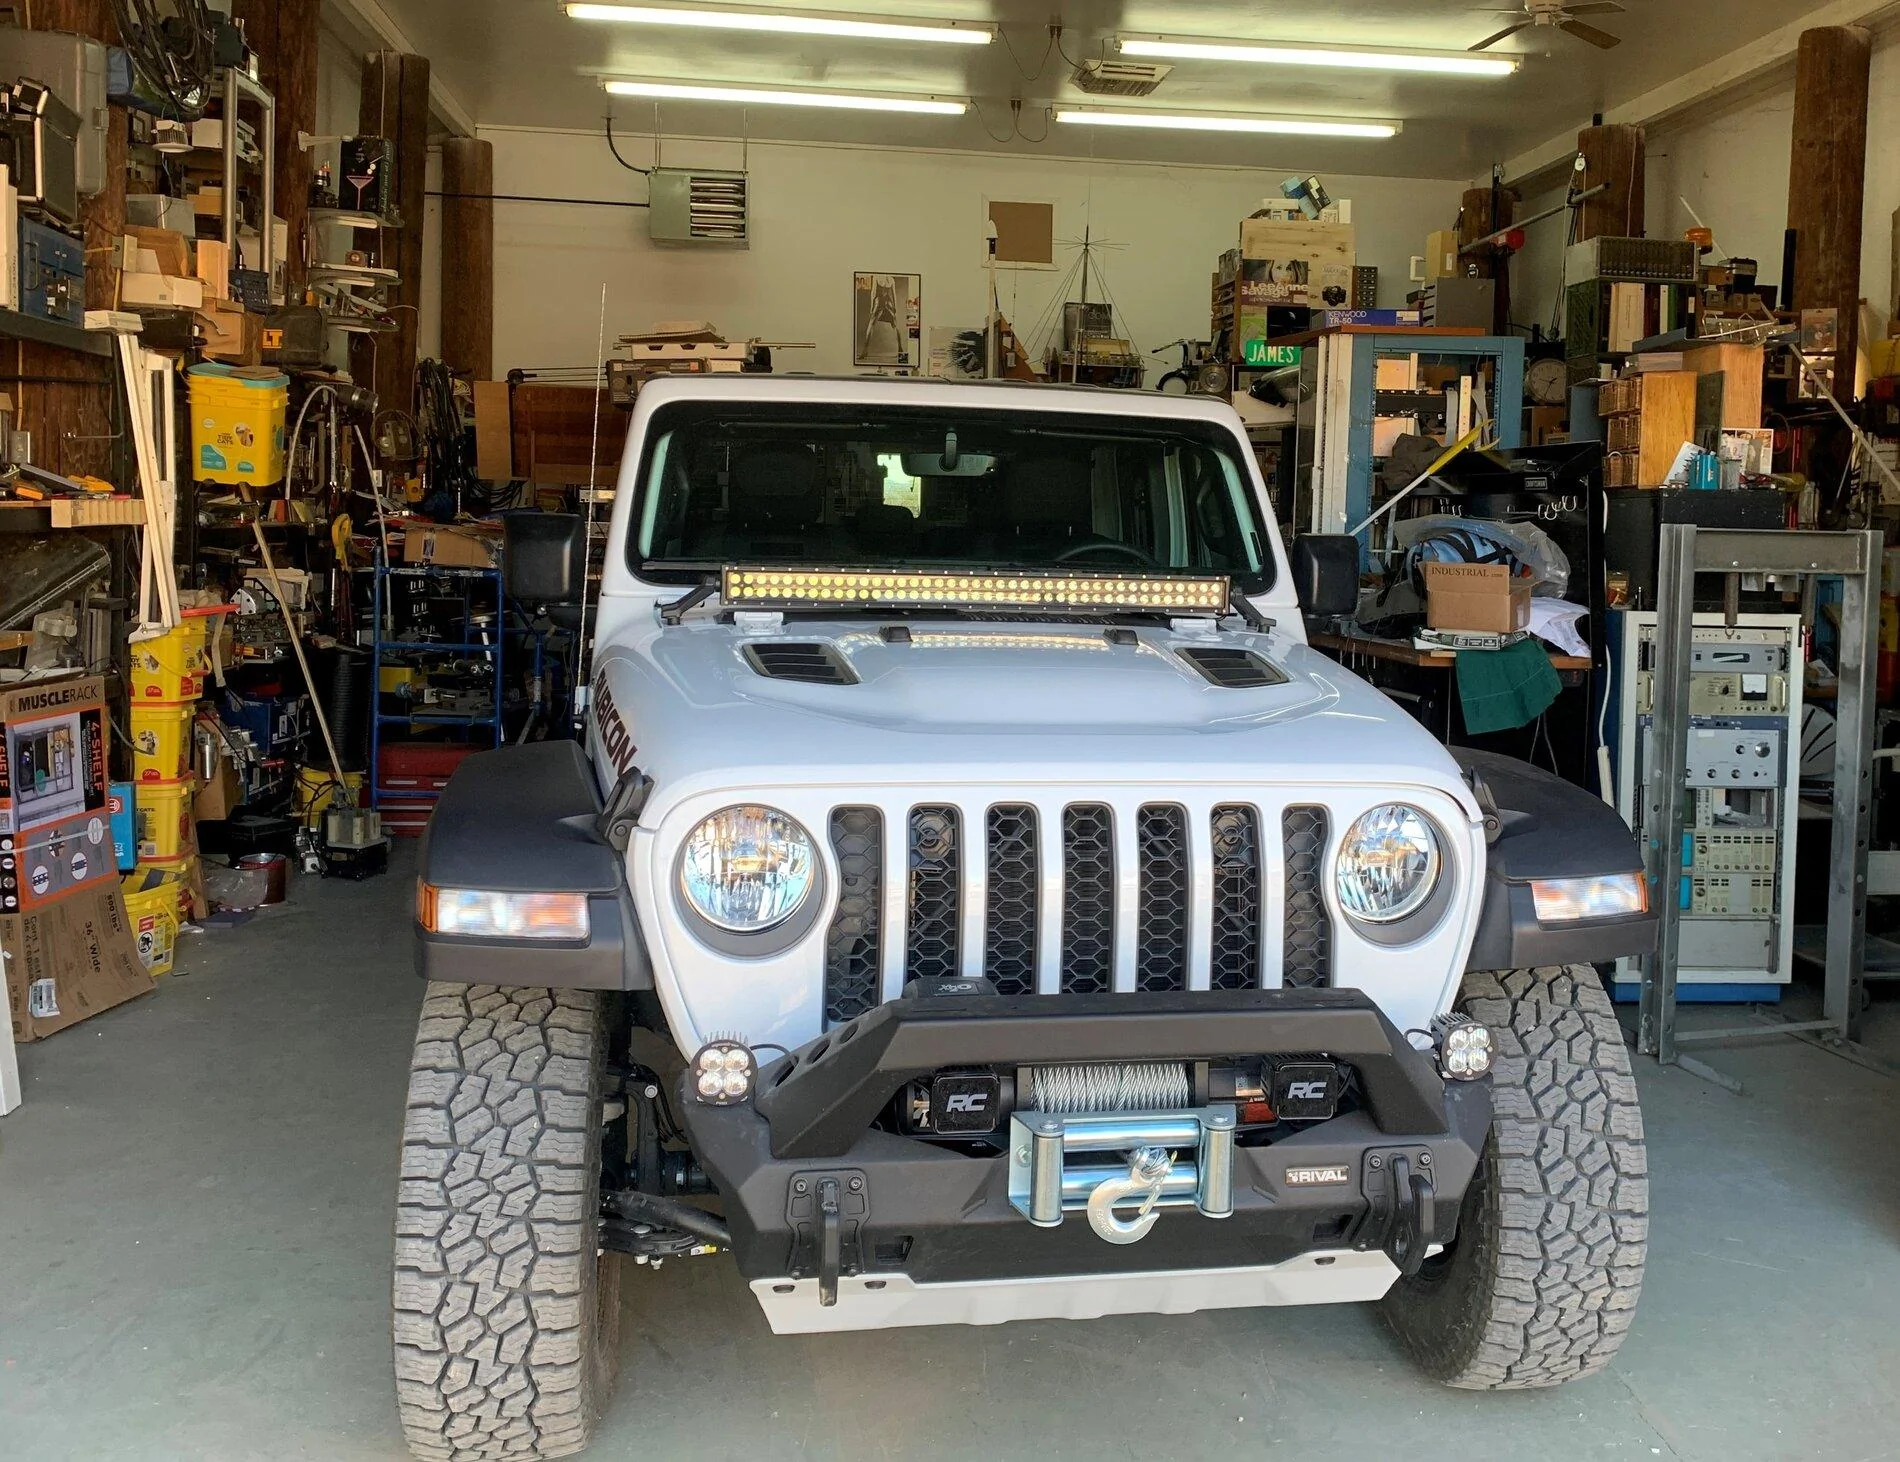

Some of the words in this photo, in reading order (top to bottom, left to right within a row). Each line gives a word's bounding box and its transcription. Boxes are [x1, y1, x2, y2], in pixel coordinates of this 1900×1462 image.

[1328, 310, 1367, 318] KENWOOD
[1249, 345, 1295, 363] JAMES
[1431, 567, 1489, 577] INDUSTRIAL
[18, 685, 98, 712] MUSCLERACK
[91, 721, 103, 791] 4-SHELF
[89, 942, 101, 974] Wide
[1287, 1081, 1327, 1099] RC
[946, 1093, 988, 1113] RC
[1300, 1170, 1348, 1183] RIVAL
